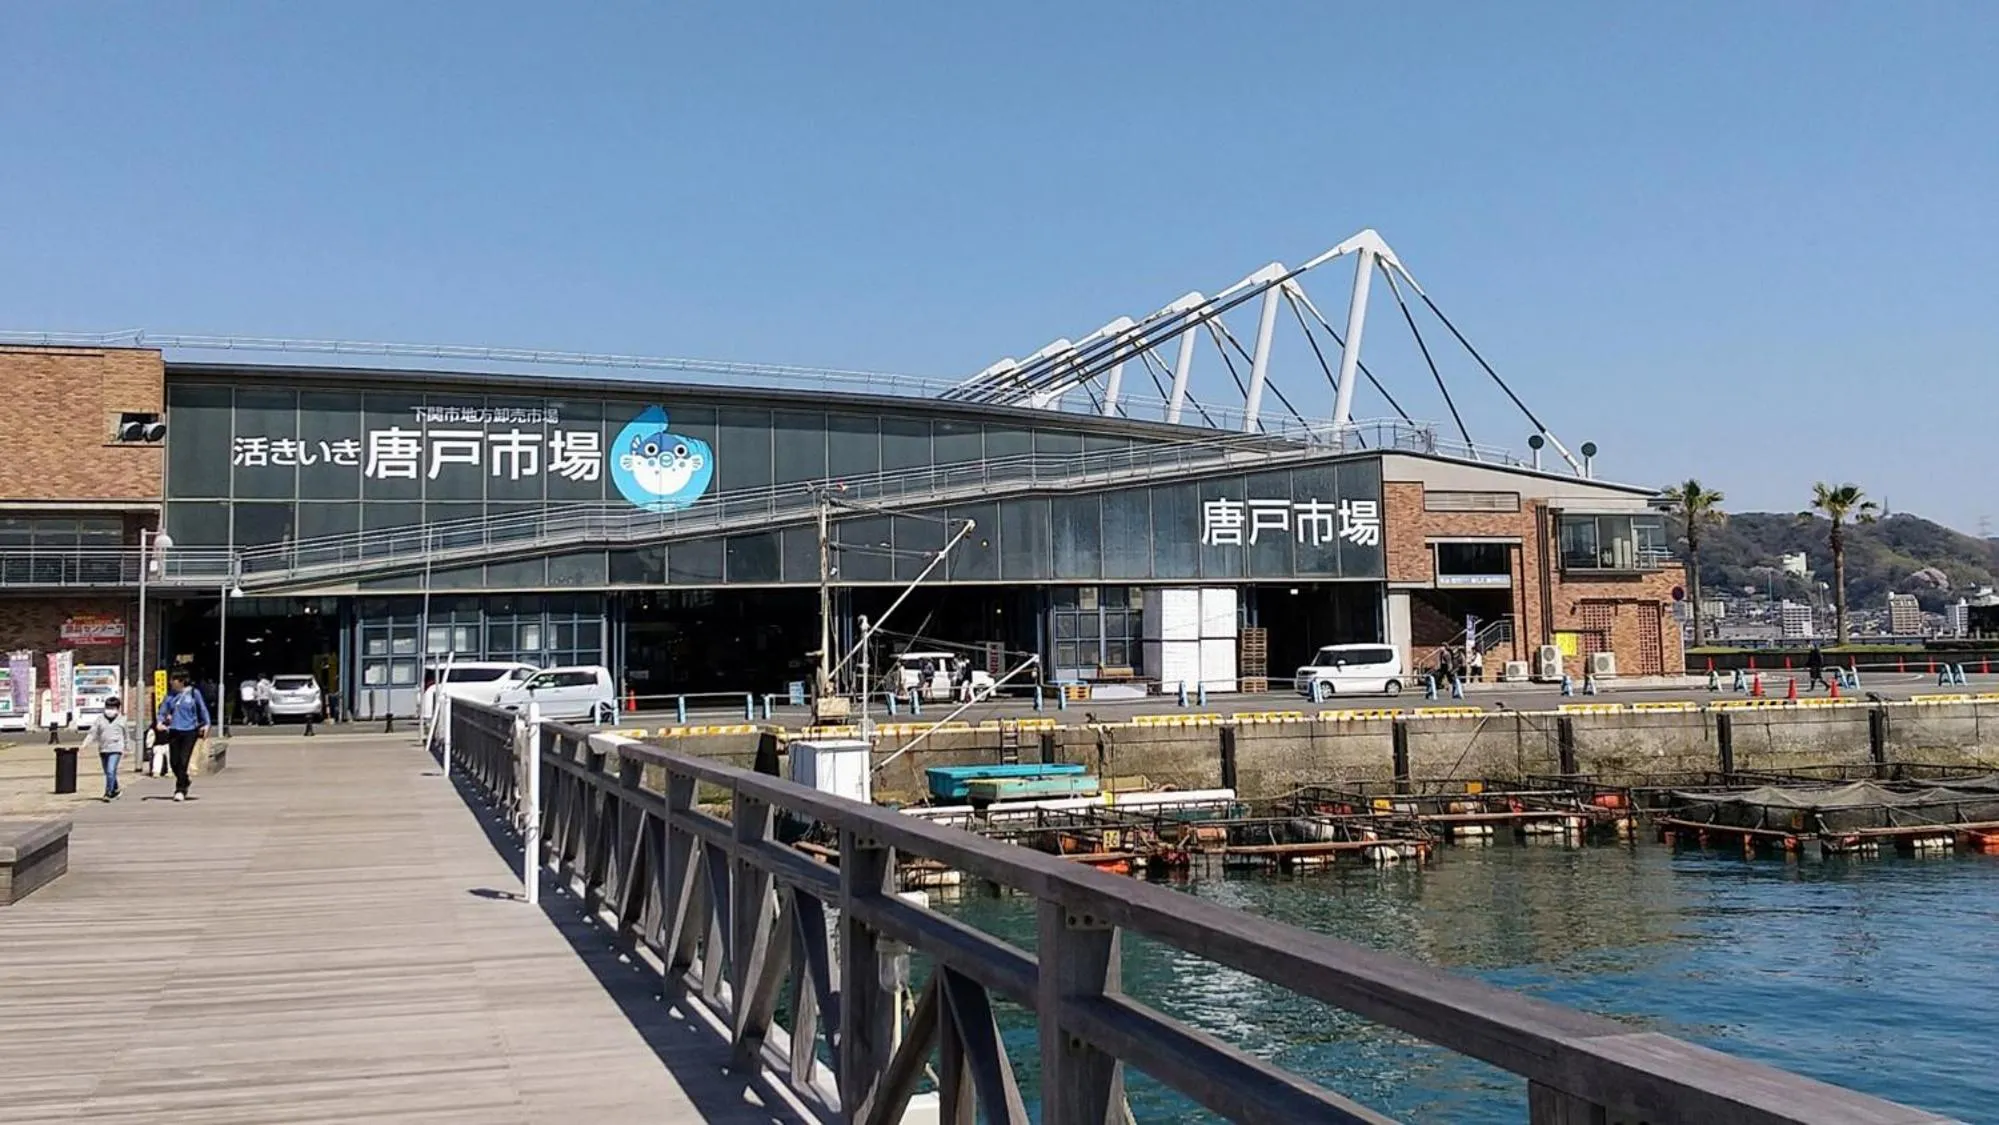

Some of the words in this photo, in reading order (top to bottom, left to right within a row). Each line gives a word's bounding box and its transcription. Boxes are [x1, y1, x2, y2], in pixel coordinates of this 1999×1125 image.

[411, 406, 559, 424] 下関市地方卸売市場
[233, 436, 361, 467] 活きいき
[364, 426, 602, 481] 唐戸市場
[1202, 498, 1380, 546] 唐戸市場
